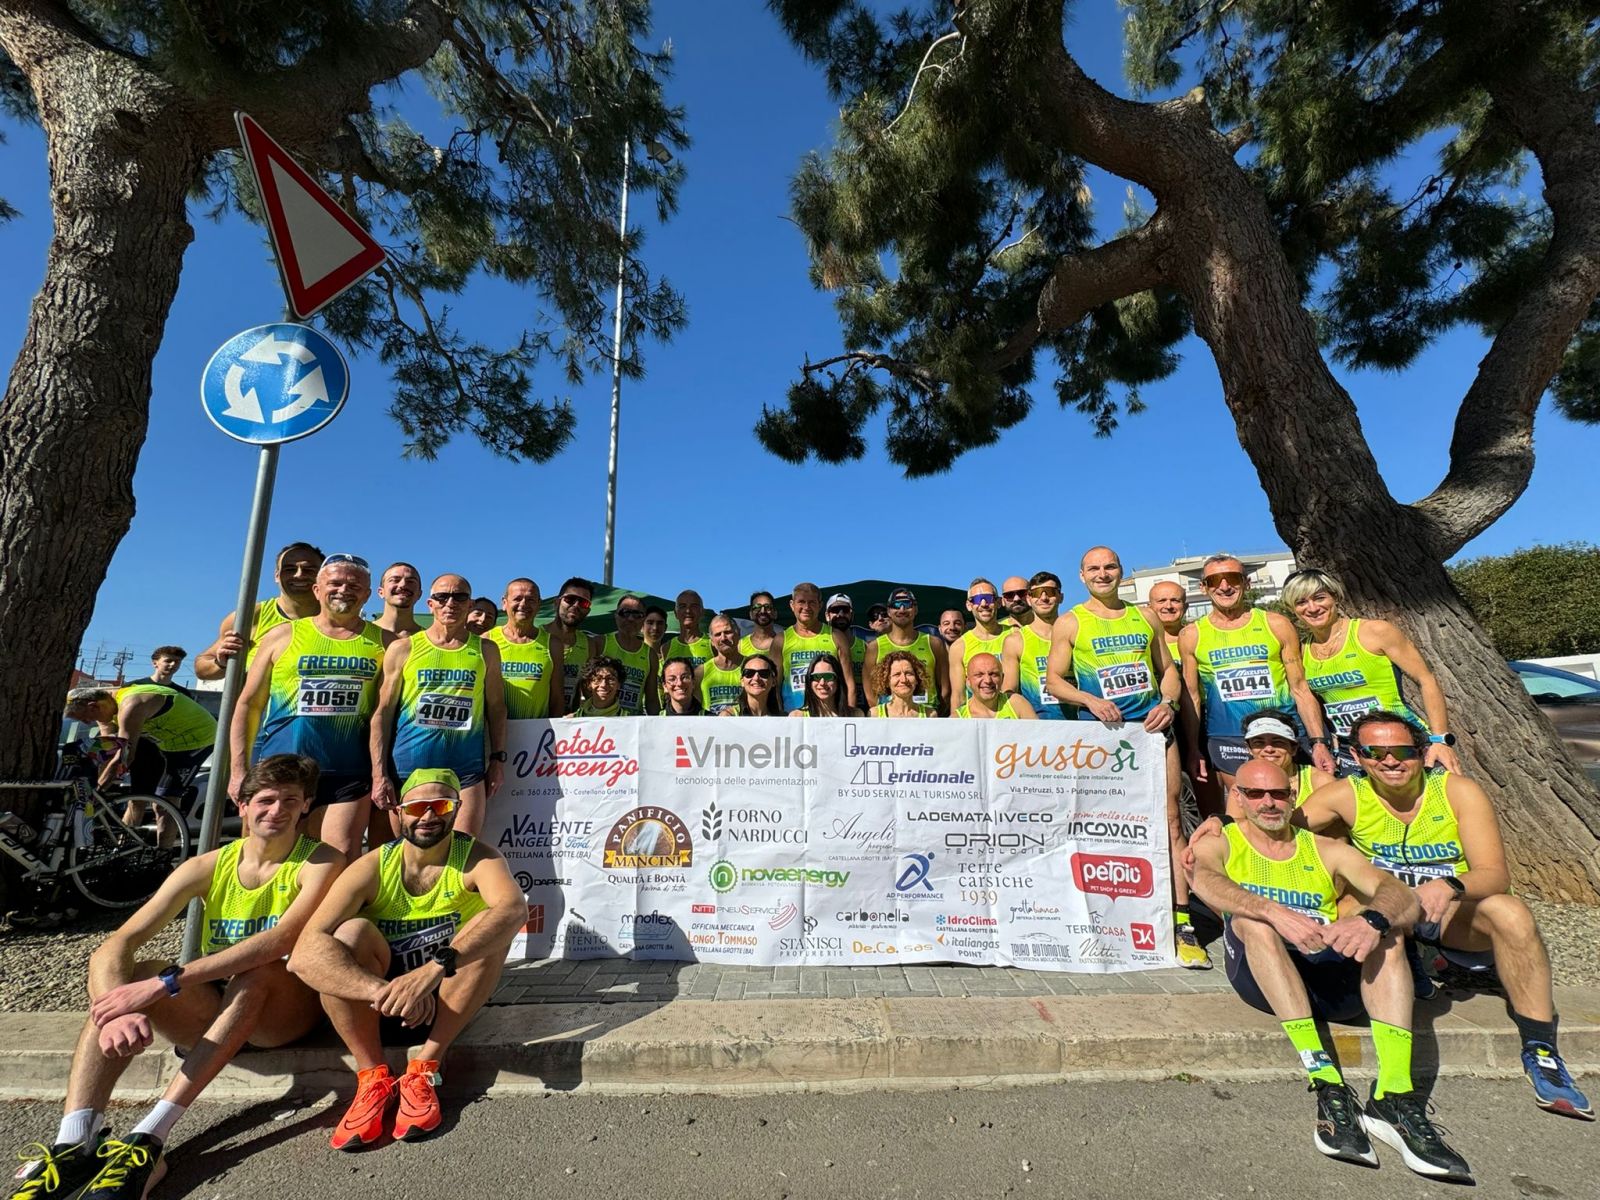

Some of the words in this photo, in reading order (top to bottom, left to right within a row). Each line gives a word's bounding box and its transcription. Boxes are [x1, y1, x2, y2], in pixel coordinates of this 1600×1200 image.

[1091, 633, 1149, 650] FREEDOGS
[1208, 644, 1269, 662] FREEDOGS
[297, 655, 378, 672] FREEDOGS
[500, 661, 543, 673] REEDOGS
[417, 669, 477, 682] FREEDOGS
[1103, 671, 1149, 690] 4063
[1308, 669, 1365, 688] REEDOGS
[1220, 675, 1271, 693] 4044
[301, 690, 360, 706] 4059
[419, 703, 470, 722] 4040
[536, 726, 616, 760] Rotolo
[845, 723, 934, 757] Lavanderia
[687, 736, 818, 769] Vinella
[513, 750, 640, 788] Vincenzo
[675, 776, 721, 786] tecnologia
[724, 776, 746, 786] delle
[749, 777, 818, 787] pavimentazioni
[838, 788, 850, 797] BY
[851, 789, 870, 798] SUD
[873, 789, 907, 798] SERVIZI
[909, 789, 921, 799] AL
[924, 790, 966, 800] TURISMO
[968, 790, 984, 799] SRL
[1071, 788, 1108, 796] Putignano
[1109, 788, 1126, 796] (BA)
[728, 809, 783, 823] FORNO
[907, 811, 993, 822] LADEMATA
[1000, 813, 1053, 823] IVECO
[512, 814, 593, 836] VALENTE
[612, 808, 686, 844] PANIFICIO
[498, 828, 560, 848] ANGELO
[728, 828, 808, 844] NARDUCCI
[944, 833, 1045, 848] ORION
[613, 855, 681, 868] MANCINI
[647, 875, 653, 883] E
[741, 867, 850, 888] novaenergy
[960, 890, 998, 906] 1939
[835, 908, 910, 923] carbonella
[947, 915, 997, 926] IdroClima
[692, 923, 719, 931] OFFICINA
[1066, 925, 1127, 937] TERMOCASA
[779, 937, 842, 950] STANISCI
[951, 936, 1000, 949] italiangas
[957, 950, 982, 958] POINT
